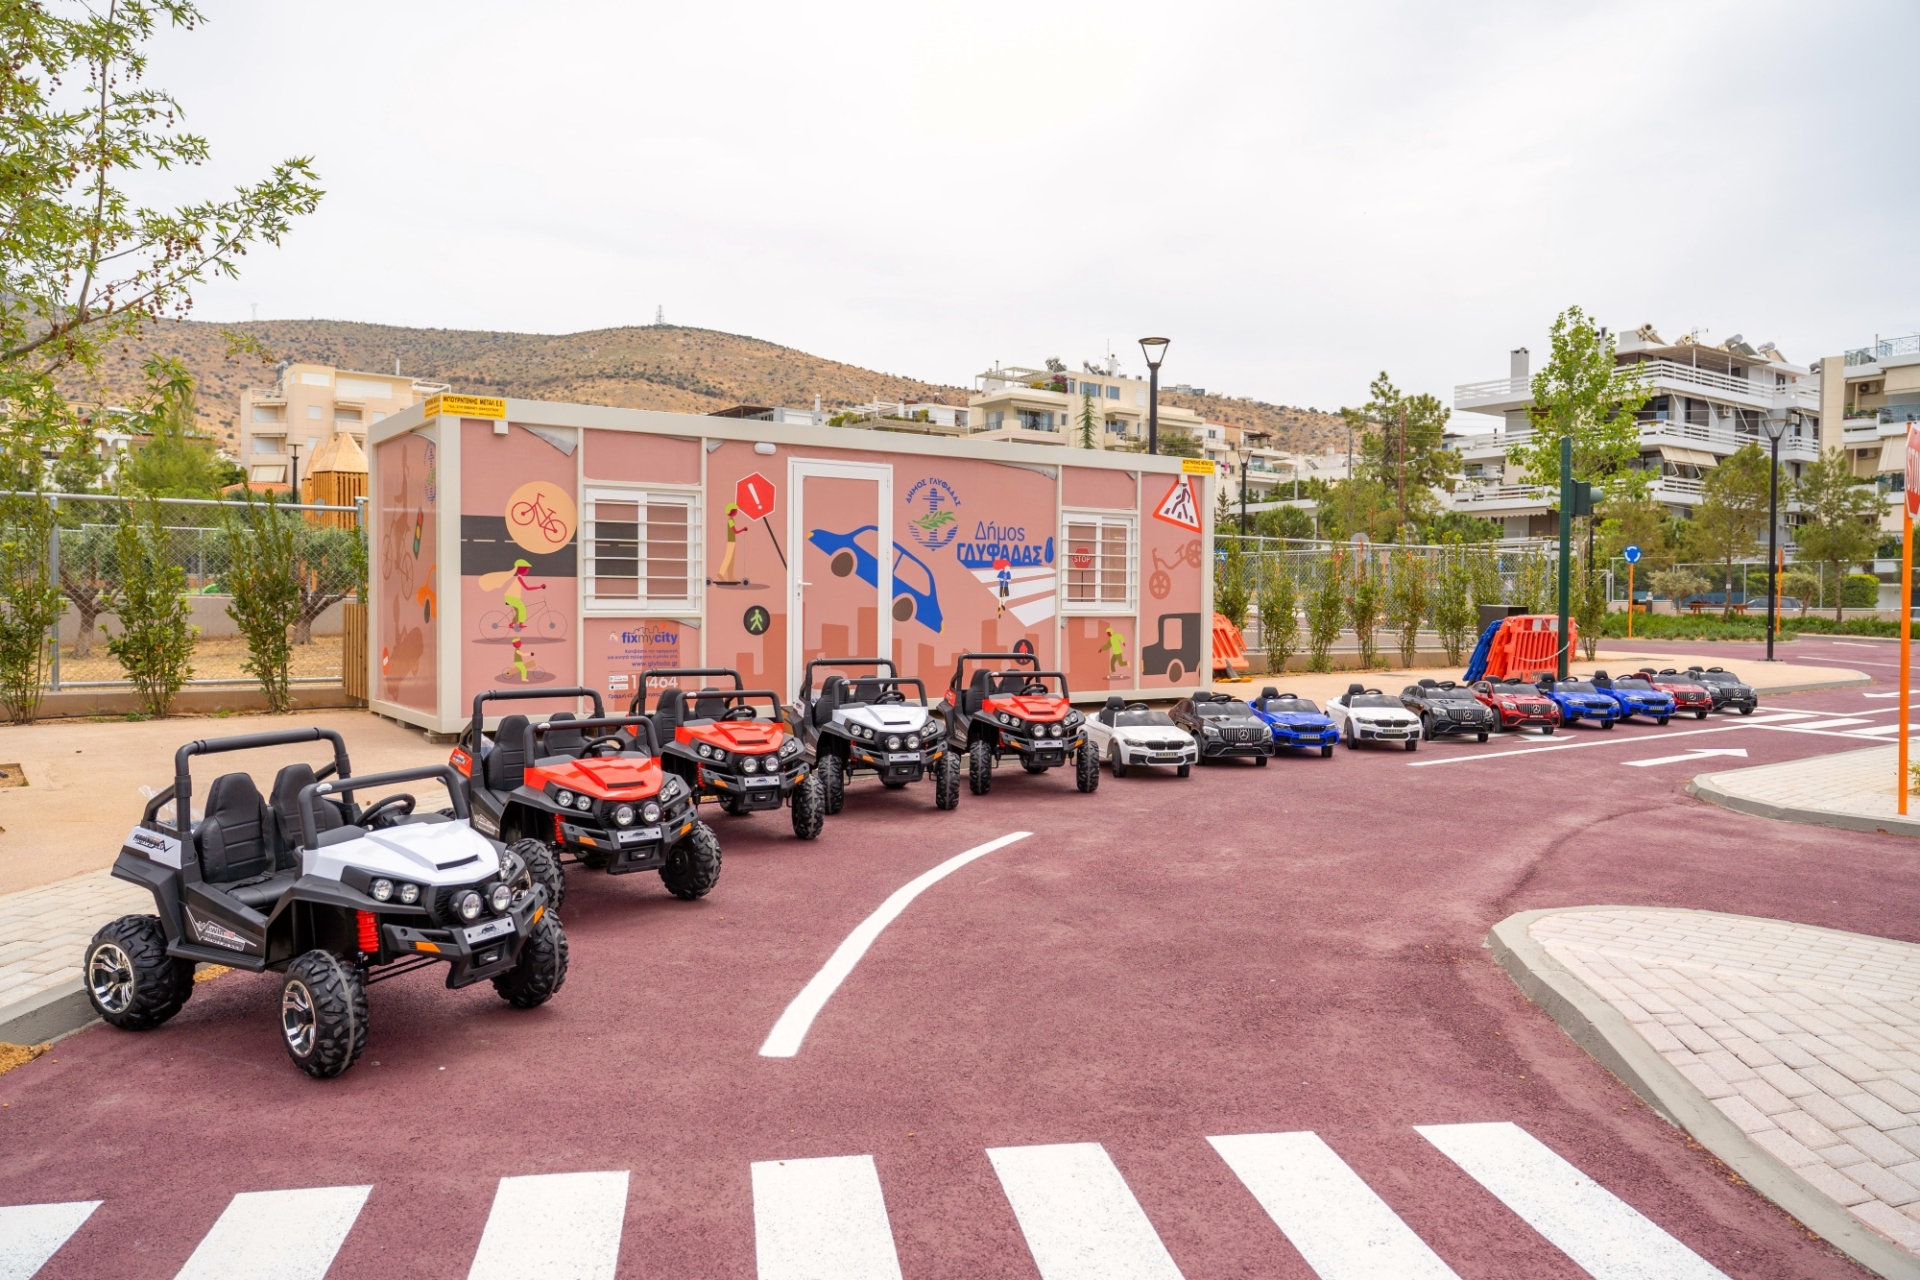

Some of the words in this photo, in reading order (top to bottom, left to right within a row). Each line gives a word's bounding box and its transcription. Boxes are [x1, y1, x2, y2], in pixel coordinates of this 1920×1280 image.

[1906, 447, 1920, 495] STO
[905, 478, 927, 504] ΔΗΜΟΣ
[929, 477, 962, 507] ΓΛΥΦΑΔΑΣ
[974, 520, 1025, 544] Δήμος
[956, 542, 1043, 565] ΓΛΥΦΑΔΑΣ
[1074, 555, 1091, 563] STOP
[621, 631, 678, 645] fixmycity
[631, 675, 678, 690] 1464
